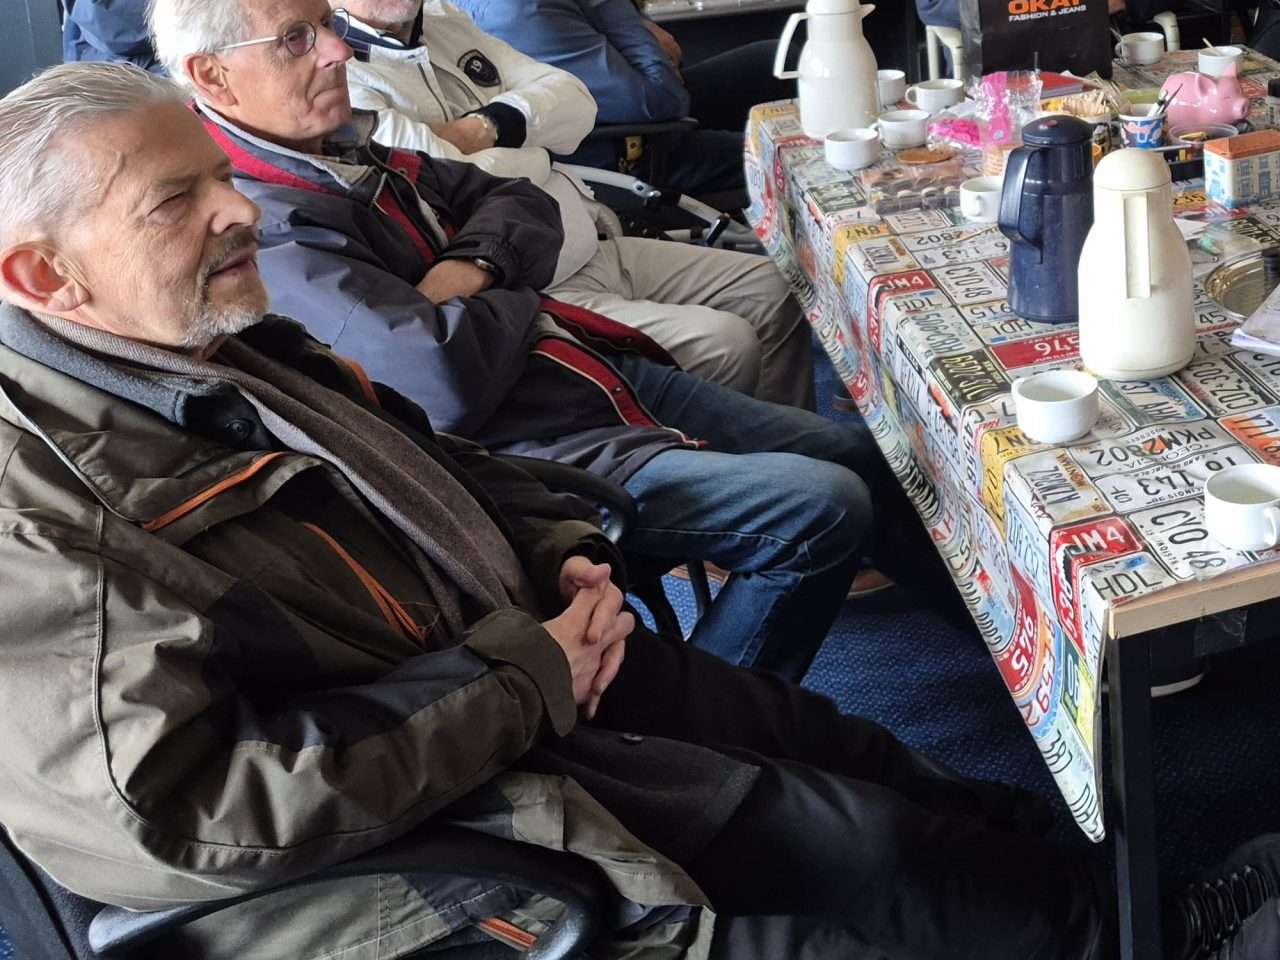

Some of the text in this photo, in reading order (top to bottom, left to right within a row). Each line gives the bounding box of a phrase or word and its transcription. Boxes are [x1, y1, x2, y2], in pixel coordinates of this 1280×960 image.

[1009, 4, 1087, 23] FASHION & JEANS
[1137, 469, 1195, 496] 143
[1068, 525, 1125, 556] JM4
[1091, 569, 1163, 601] HDL
